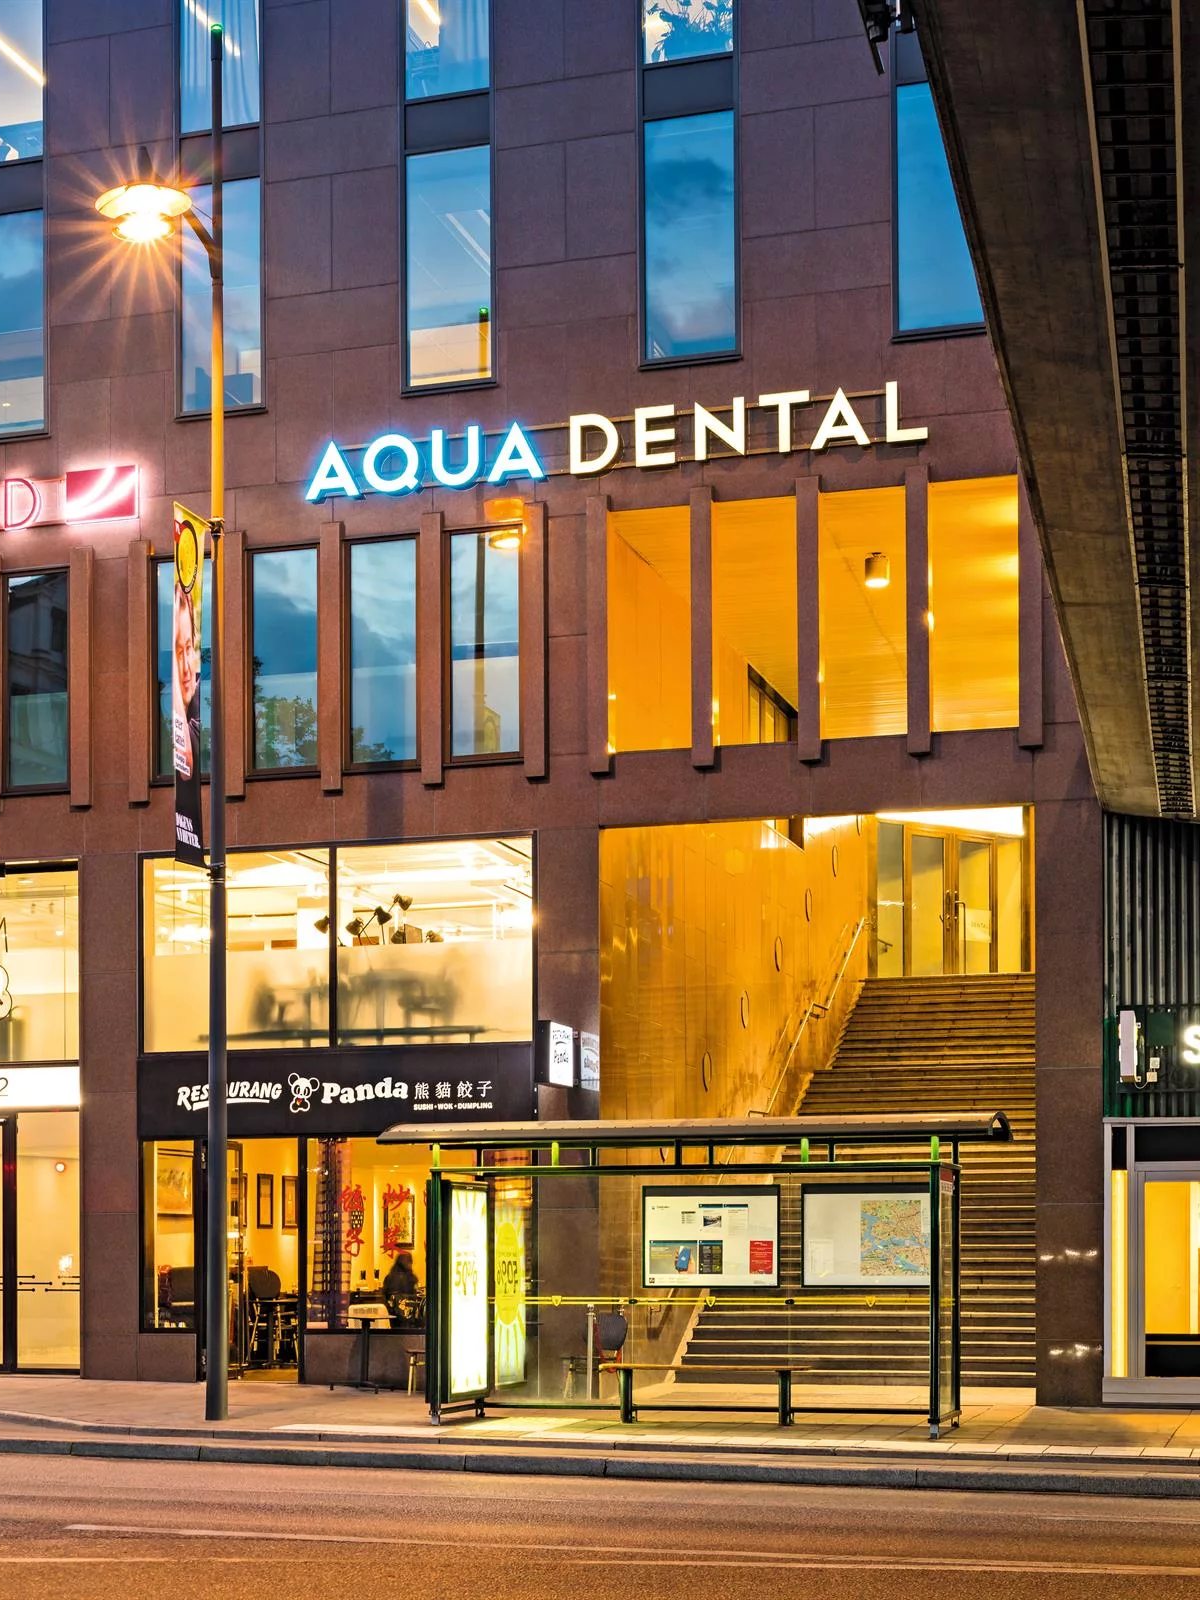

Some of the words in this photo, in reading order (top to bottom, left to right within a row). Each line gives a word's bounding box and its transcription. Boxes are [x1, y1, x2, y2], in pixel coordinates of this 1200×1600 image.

[305, 420, 545, 502] AQUA
[569, 380, 930, 476] DENTAL
[176, 1080, 283, 1111] RESURANG
[320, 1077, 409, 1104] Panda
[414, 1080, 493, 1100] 熊貓餃子
[457, 1102, 493, 1110] DUMPLING
